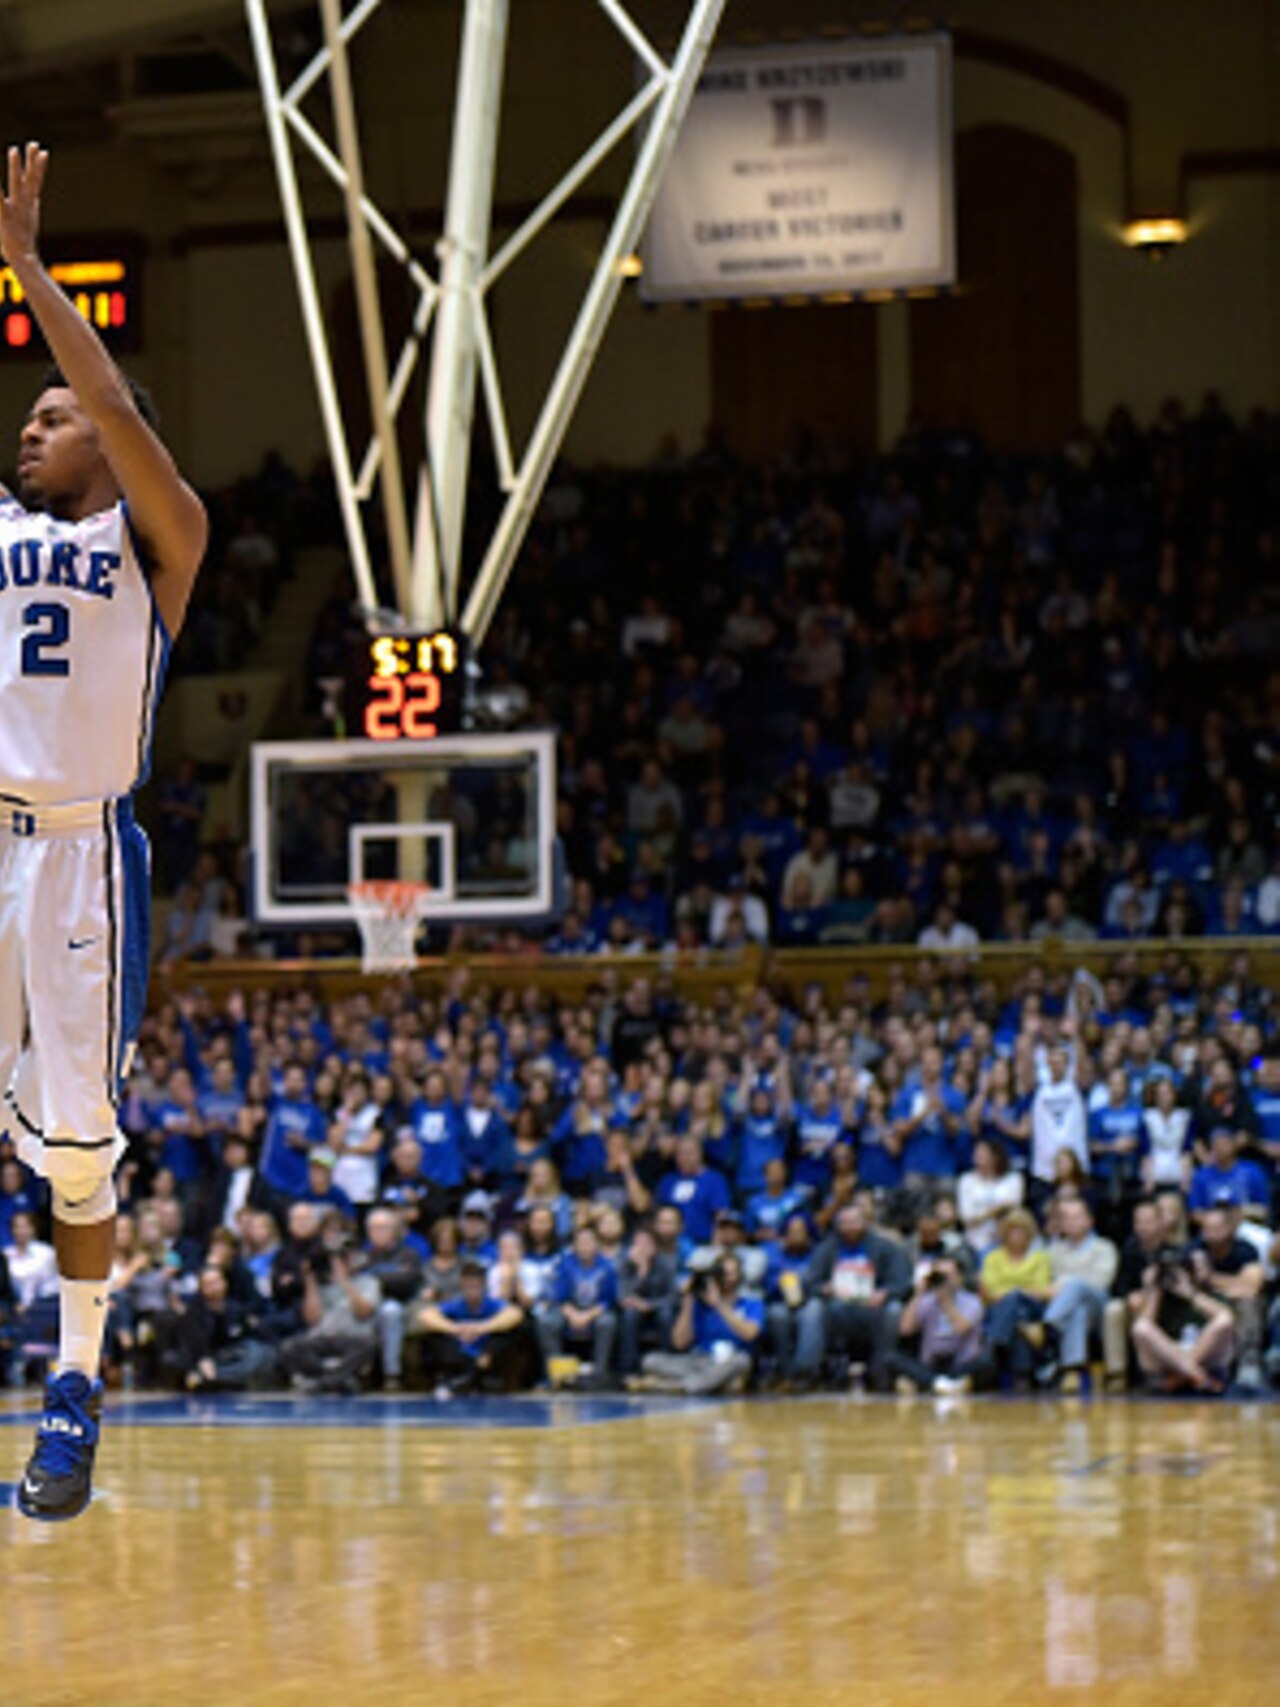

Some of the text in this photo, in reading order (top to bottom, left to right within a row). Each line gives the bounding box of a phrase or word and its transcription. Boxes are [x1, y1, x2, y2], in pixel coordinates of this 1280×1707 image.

[21, 602, 70, 677] 2
[371, 633, 458, 677] 5:17
[365, 673, 441, 741] 22
